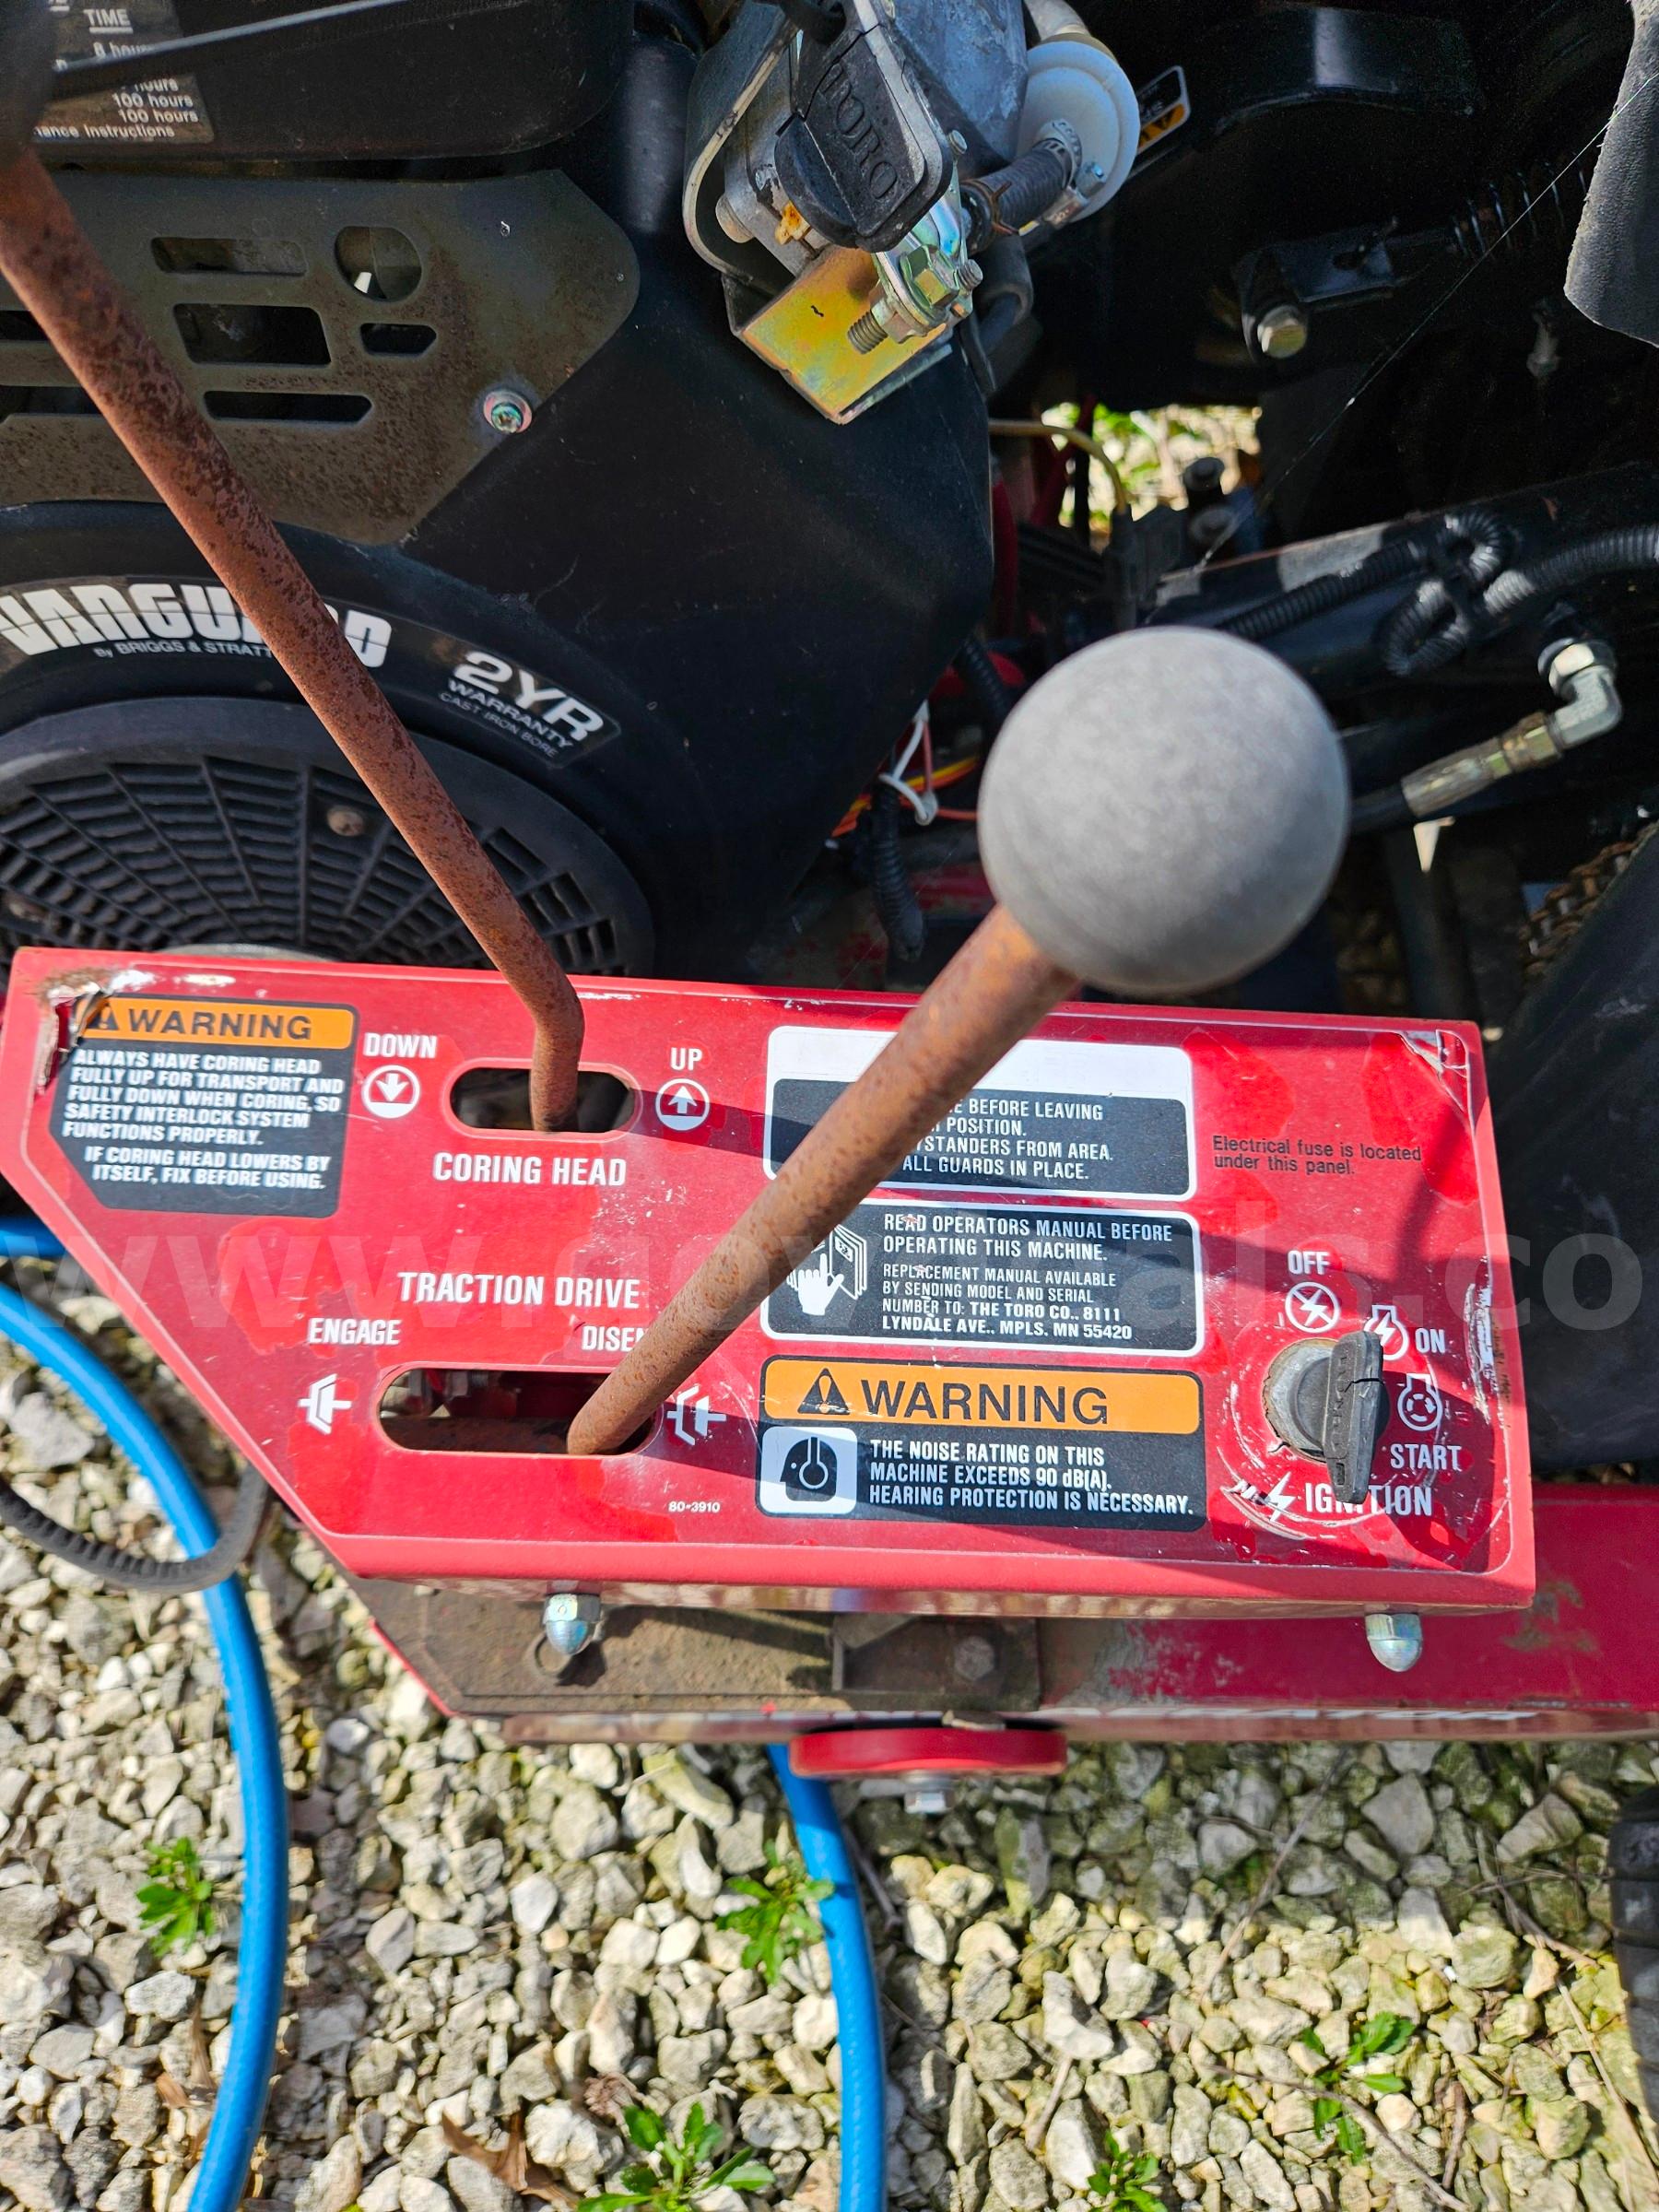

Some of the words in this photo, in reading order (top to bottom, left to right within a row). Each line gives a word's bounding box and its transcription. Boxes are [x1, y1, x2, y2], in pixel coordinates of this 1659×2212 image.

[83, 8, 131, 26] TIME
[112, 92, 144, 108] 100
[147, 92, 194, 108] hours
[118, 109, 149, 123] 100
[152, 109, 199, 123] hours
[83, 124, 175, 138] Instructions
[818, 63, 898, 200] TORO
[0, 583, 392, 668] VANGUD
[93, 647, 114, 658] By
[114, 641, 185, 654] BRIGGS
[187, 641, 203, 653] &
[453, 651, 605, 741] 2YR
[439, 692, 482, 713] CAST
[484, 712, 521, 735] IRON
[521, 731, 559, 758] BORE
[448, 678, 574, 748] WARRANTY
[128, 1008, 312, 1040] WARNING
[363, 1032, 438, 1058] DOWN
[74, 1049, 149, 1068] ALWAYS
[151, 1053, 201, 1070] HAVE
[203, 1054, 270, 1072] CORING
[271, 1057, 322, 1075] HEAD
[670, 1047, 703, 1071] UP
[71, 1066, 125, 1084] FULLY
[127, 1069, 155, 1086] UP
[157, 1070, 193, 1088] FOR
[195, 1073, 304, 1093] TRANSPORT
[304, 1077, 345, 1094] AND
[67, 1084, 124, 1102] FULLY
[124, 1087, 180, 1105] DOWN
[183, 1090, 238, 1107] WHEN
[240, 1092, 312, 1112] CORING,
[313, 1096, 342, 1112] SO
[969, 1098, 1030, 1117] BEFORE
[1035, 1101, 1104, 1121] LEAVING
[64, 1103, 135, 1122] SAFETY
[135, 1106, 235, 1125] INTERLOCK
[235, 1110, 312, 1128] SYSTEM
[947, 1116, 1027, 1136] POSITION.
[62, 1121, 166, 1141] FUNCTIONS
[167, 1126, 265, 1146] PROPERLY.
[85, 1146, 104, 1162] IF
[104, 1147, 175, 1165] CORING
[176, 1149, 228, 1168] HEAD
[228, 1152, 303, 1171] LOWERS
[304, 1155, 332, 1171] BY
[916, 1135, 1011, 1156] STANDERS
[1017, 1139, 1062, 1159] FROM
[1067, 1142, 1113, 1161] AREA.
[1213, 1135, 1290, 1154] Electrical
[1298, 1140, 1334, 1158] fuse
[1340, 1142, 1354, 1158] is
[1360, 1144, 1421, 1161] located
[92, 1164, 159, 1185] ITSELF,
[160, 1167, 193, 1182] FIX
[194, 1168, 262, 1187] BEFORE
[263, 1171, 326, 1190] USING.
[433, 1152, 541, 1183] CORING
[552, 1157, 627, 1187] HEAD
[902, 1156, 933, 1172] ALL
[938, 1157, 1005, 1176] GUARDS
[1010, 1159, 1027, 1177] IN
[1033, 1160, 1089, 1180] PLACE.
[1215, 1154, 1260, 1169] under
[1268, 1156, 1298, 1171] this
[1306, 1159, 1355, 1176] panel.
[884, 1214, 926, 1231] READ
[933, 1216, 1030, 1236] OPERATORS
[1036, 1219, 1106, 1239] MANUAL
[1111, 1222, 1172, 1241] BEFORE
[883, 1236, 977, 1256] OPERATING
[983, 1239, 1021, 1257] THIS
[1028, 1241, 1108, 1261] MACHINE.
[883, 1263, 979, 1281] REPLACEMENT
[985, 1267, 1041, 1284] MANUAL
[1045, 1270, 1116, 1287] AVAILABLE
[1287, 1250, 1330, 1275] OFF
[397, 1272, 545, 1305] TRACTION
[555, 1277, 641, 1309] DRIVE
[882, 1280, 900, 1295] BY
[904, 1281, 962, 1298] SENDING
[967, 1284, 1012, 1300] MODEL
[1017, 1287, 1043, 1301] AND
[1048, 1288, 1095, 1303] SERIAL
[882, 1298, 939, 1314] NUMBER
[944, 1300, 965, 1315] TO:
[970, 1301, 999, 1317] THE
[1005, 1302, 1045, 1318] TORO
[1083, 1307, 1121, 1322] 8111
[307, 1317, 403, 1346] ENGAGE
[882, 1315, 952, 1332] LYNDALE
[1000, 1321, 1049, 1336] MPLS.
[1053, 1323, 1079, 1336] MN
[1083, 1324, 1133, 1340] 55420
[1415, 1327, 1446, 1354] ON
[861, 1379, 1109, 1425] WARNING
[870, 1439, 902, 1460] THE
[909, 1441, 959, 1463] NOISE
[966, 1443, 1030, 1465] RATING
[1035, 1445, 1059, 1465] ON
[1065, 1446, 1105, 1468] THIS
[1390, 1443, 1463, 1472] START
[870, 1463, 948, 1484] MACHINE
[955, 1465, 1031, 1487] EXCEEDS
[1035, 1468, 1058, 1488] 90
[1062, 1468, 1112, 1493] dB(A).
[668, 1500, 721, 1513] 80-3910
[869, 1485, 944, 1507] HEARING
[950, 1488, 1058, 1511] PROTECTION
[1064, 1491, 1081, 1512] IS
[1087, 1491, 1194, 1515] NECESSARY.
